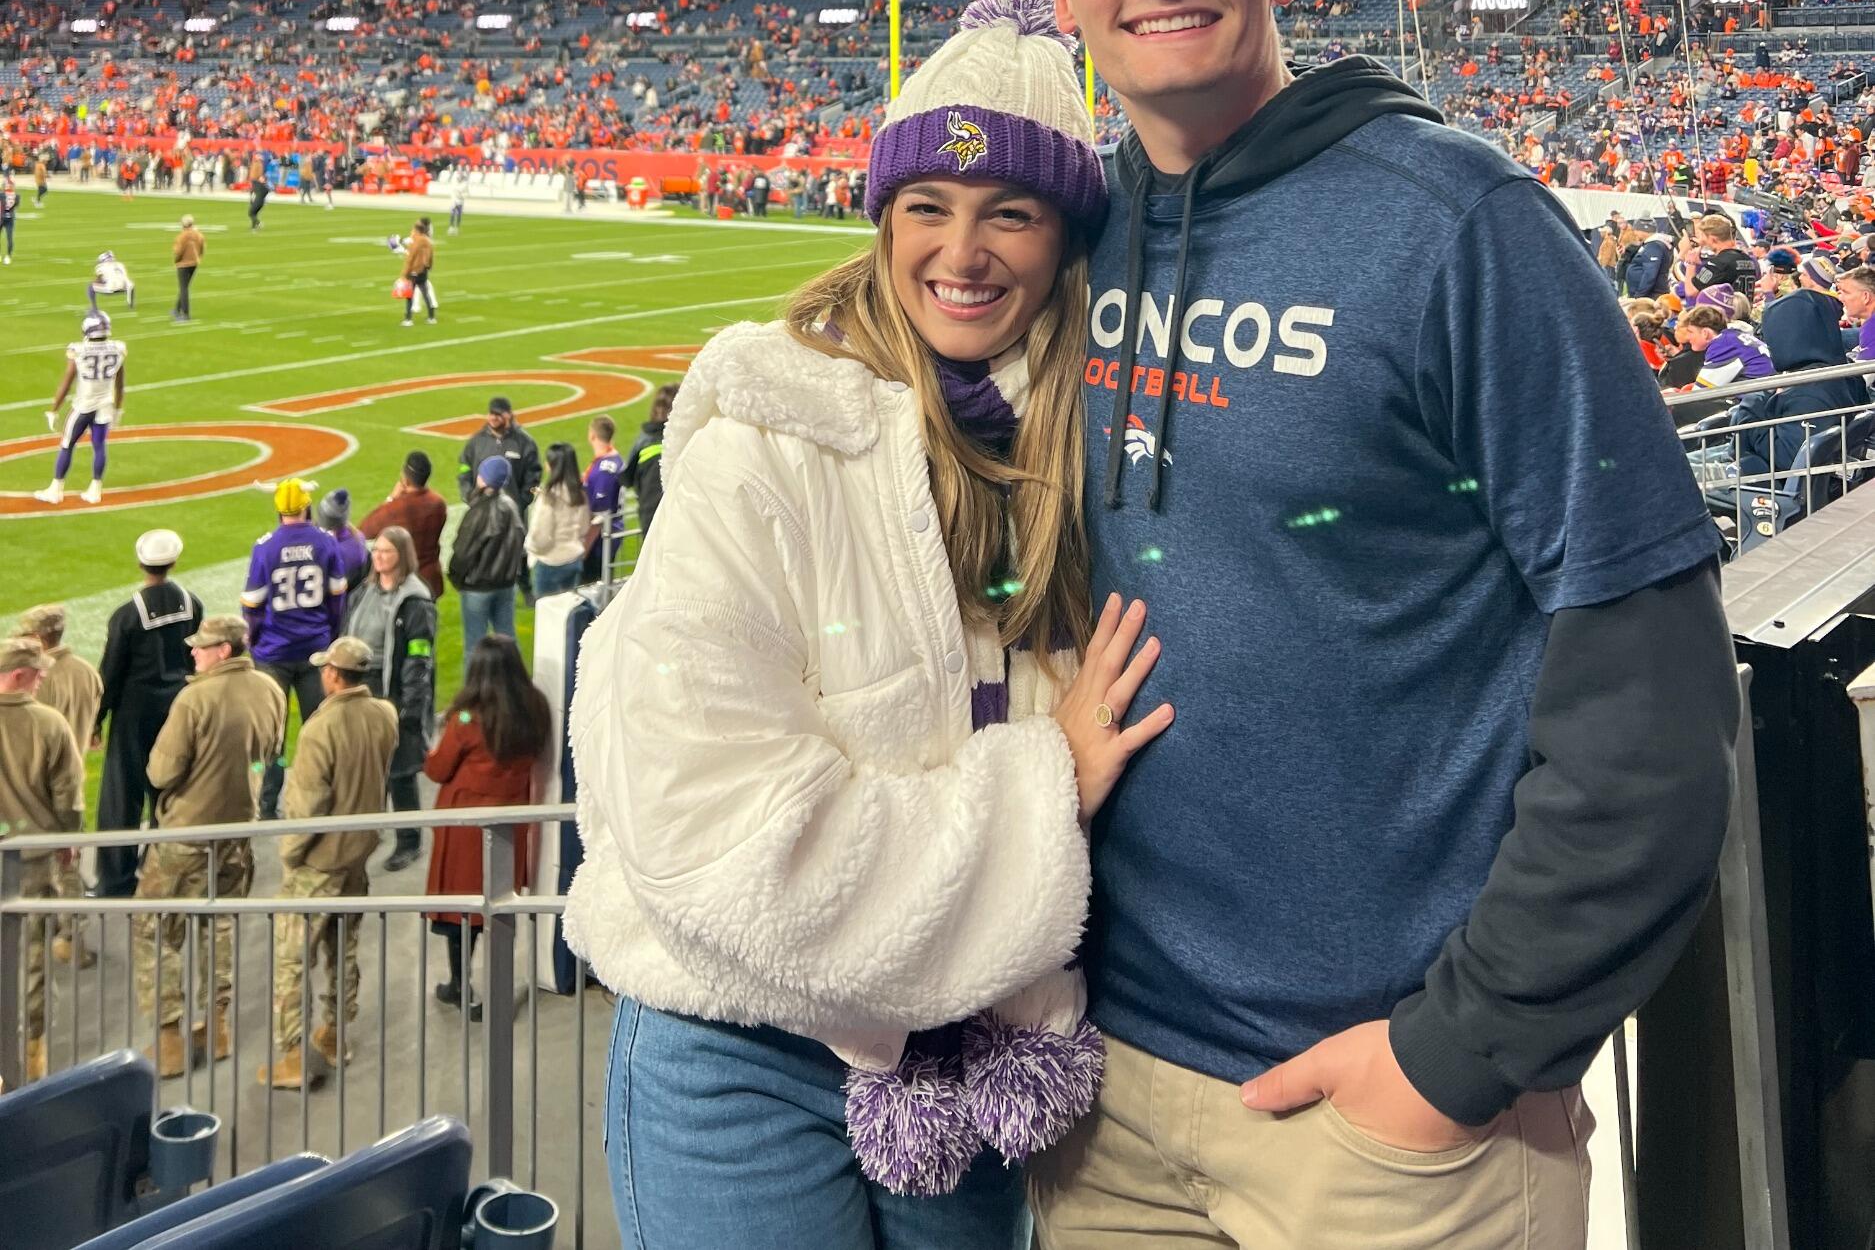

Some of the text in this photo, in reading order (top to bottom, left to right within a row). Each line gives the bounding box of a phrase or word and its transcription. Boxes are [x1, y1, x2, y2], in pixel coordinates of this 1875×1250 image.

[1086, 285, 1336, 378] ONCOS
[82, 353, 119, 381] 32
[1084, 357, 1230, 409] OOTBALL
[271, 564, 325, 612] 33
